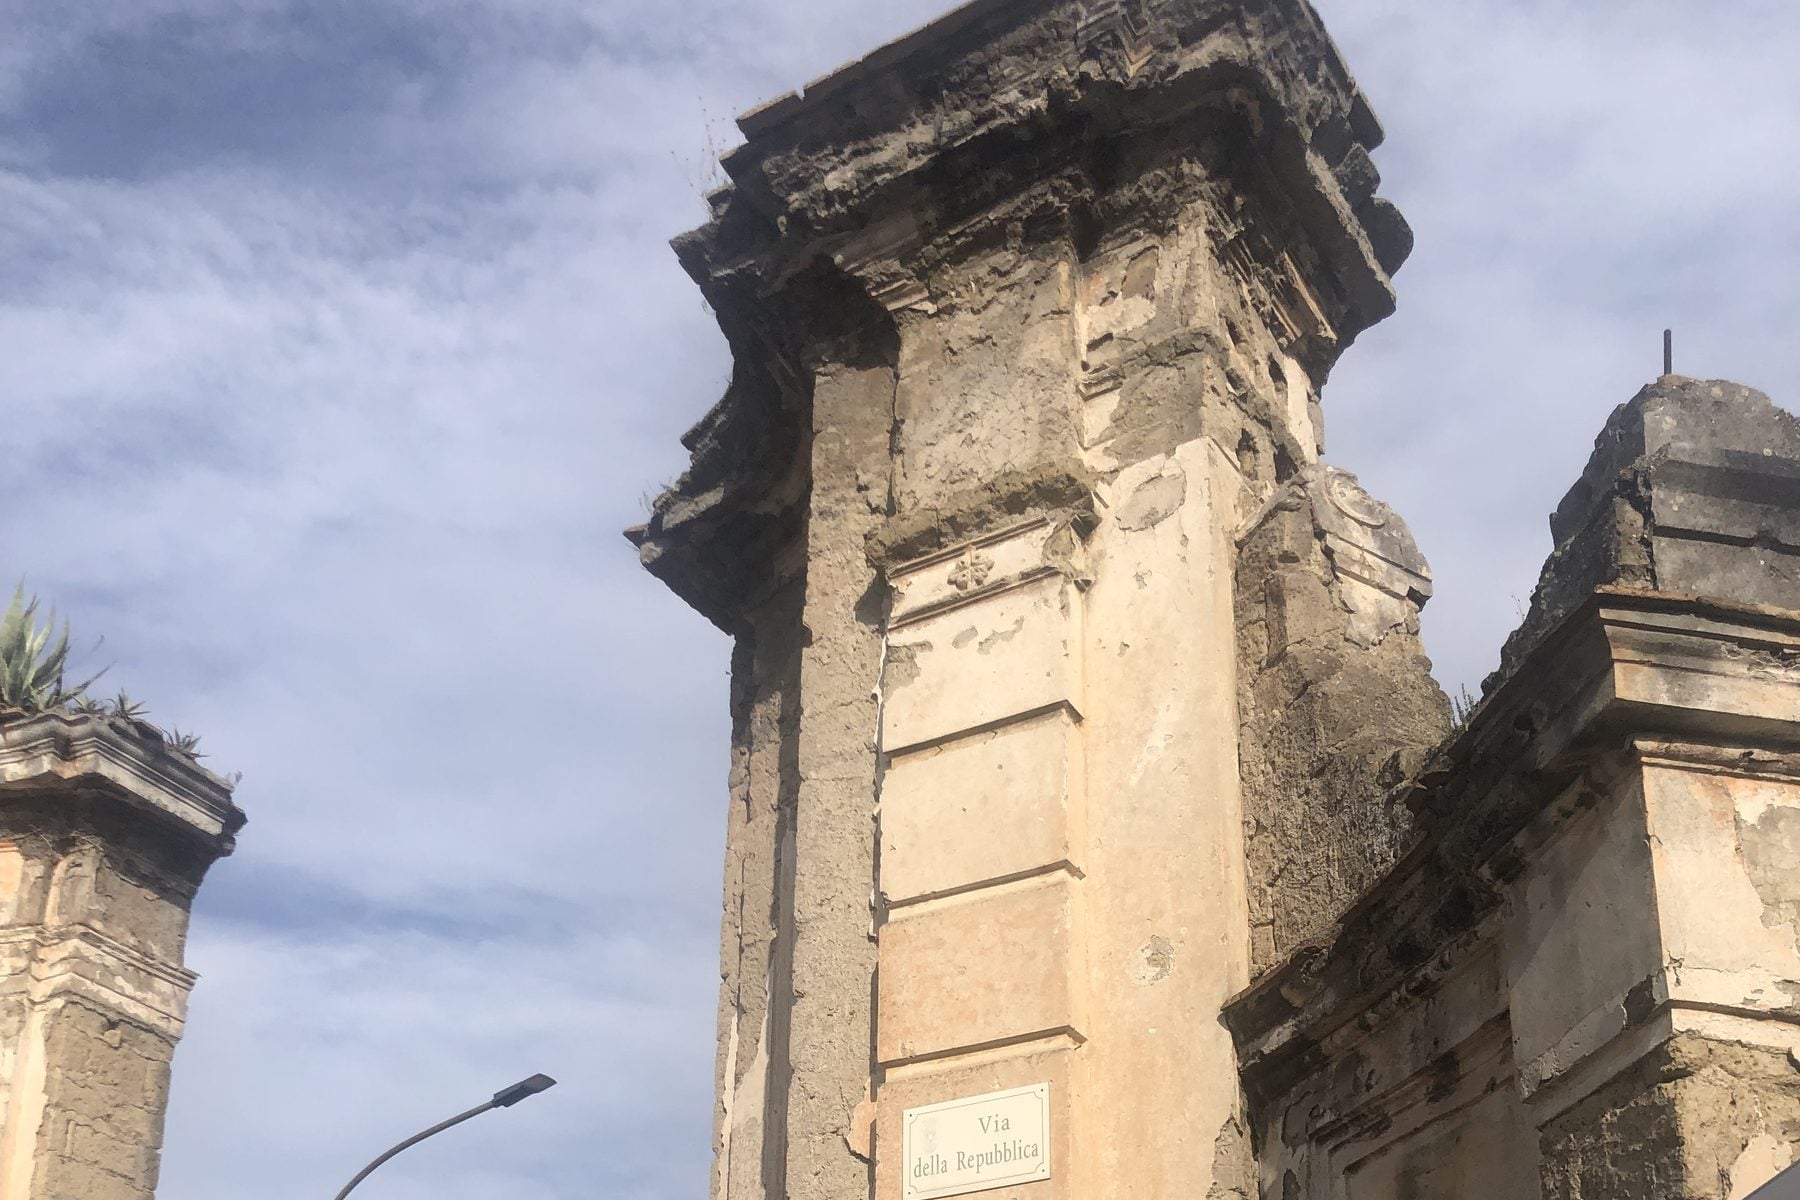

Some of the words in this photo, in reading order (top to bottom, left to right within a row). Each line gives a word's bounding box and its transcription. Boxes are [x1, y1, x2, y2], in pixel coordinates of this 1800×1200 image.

[978, 1114, 1011, 1134] Via
[914, 1154, 948, 1178] della
[957, 1139, 1039, 1174] Repubblica
